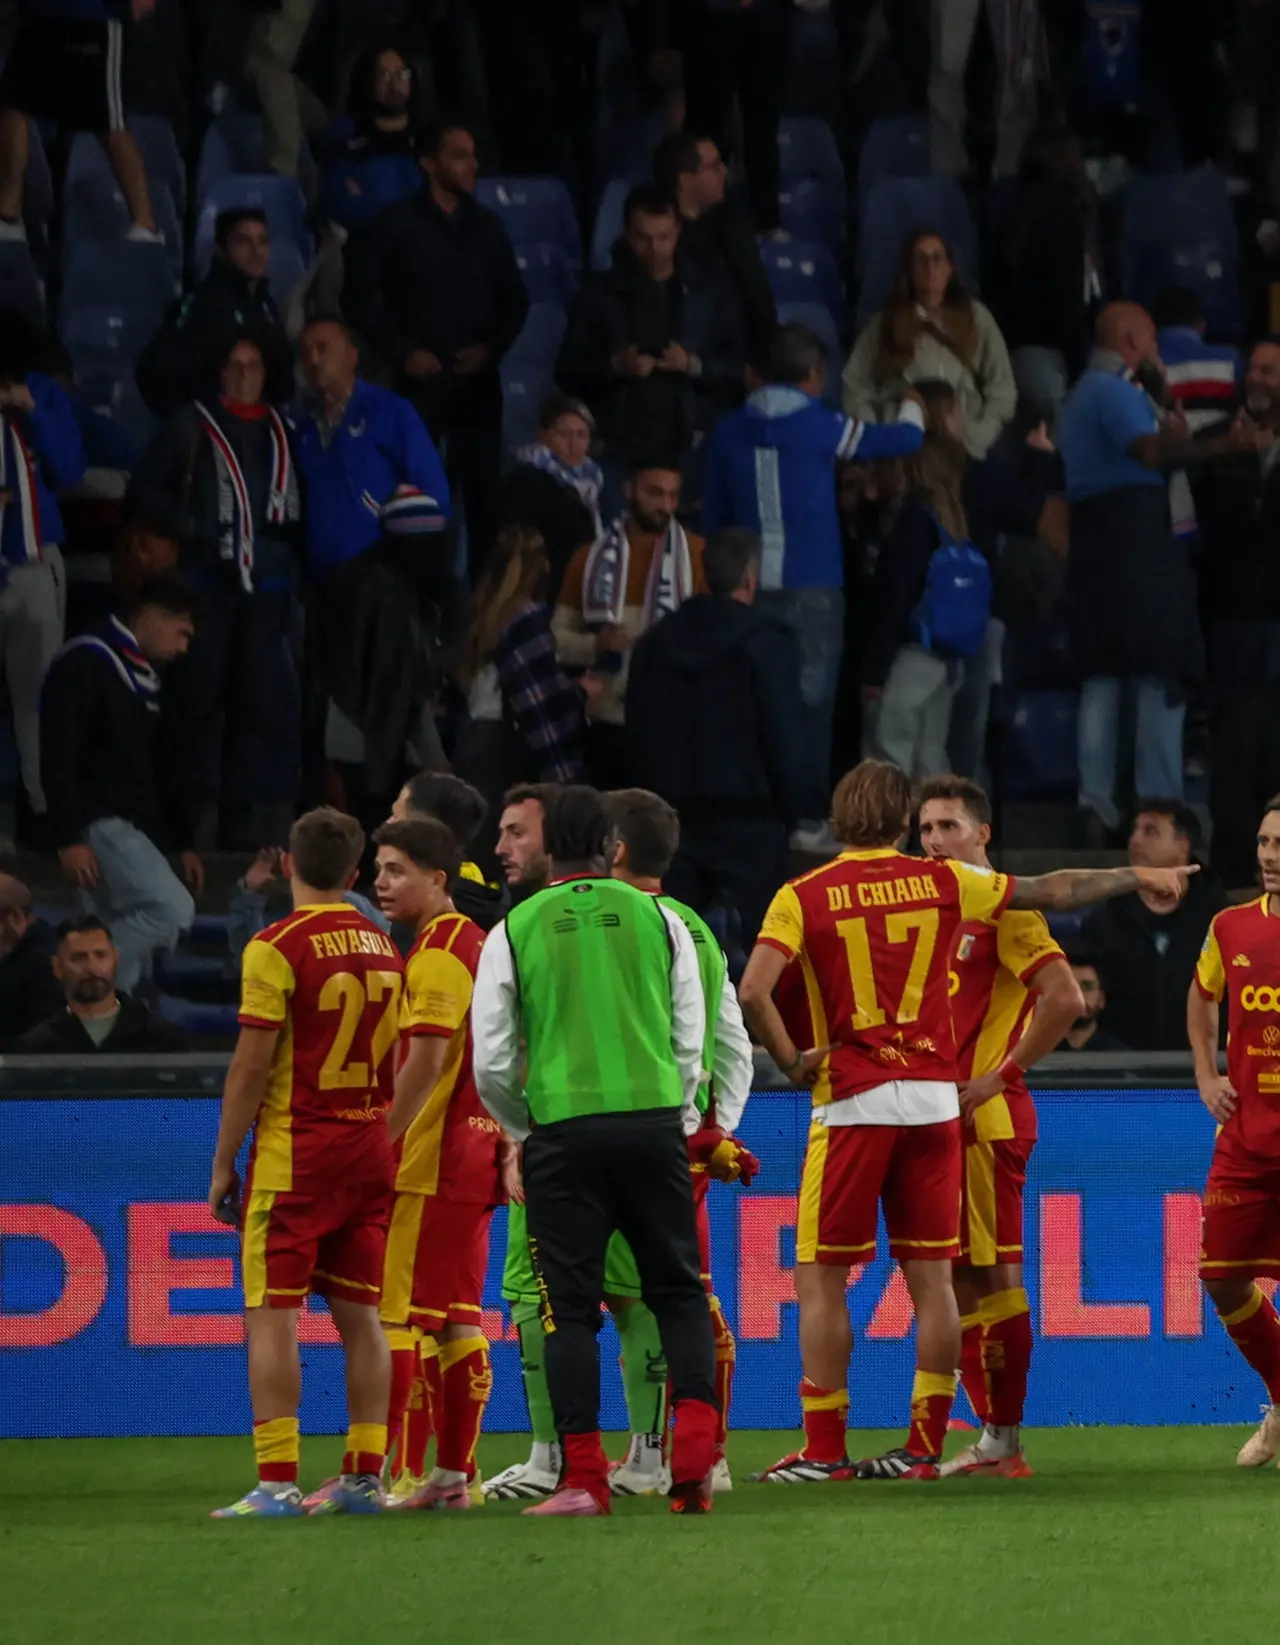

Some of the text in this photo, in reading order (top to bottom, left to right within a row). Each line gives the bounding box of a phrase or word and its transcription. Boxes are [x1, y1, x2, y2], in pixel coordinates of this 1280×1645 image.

[826, 874, 940, 911] DI CHIARA
[836, 907, 939, 1030] 17
[318, 969, 402, 1091] 27
